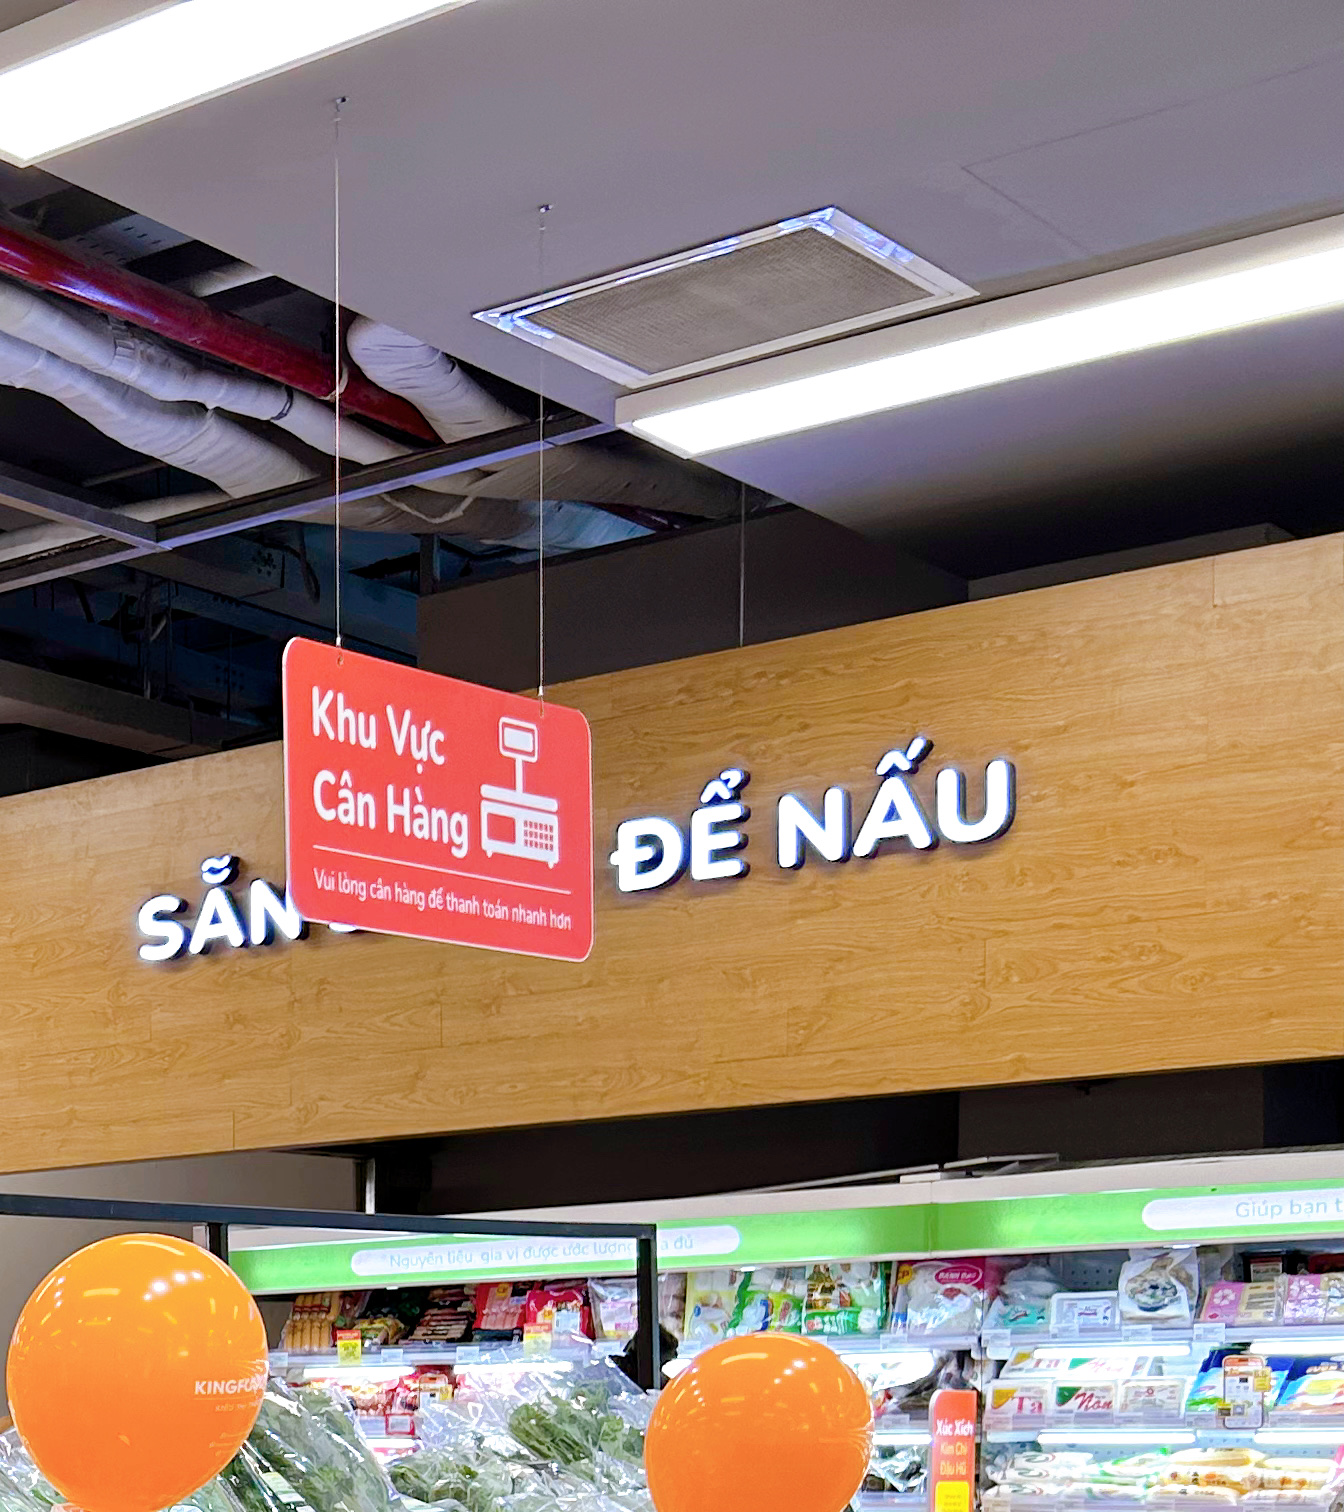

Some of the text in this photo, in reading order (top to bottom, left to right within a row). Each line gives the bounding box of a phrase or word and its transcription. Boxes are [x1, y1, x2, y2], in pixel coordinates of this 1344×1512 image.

[312, 685, 446, 774] Khu Vực
[313, 769, 469, 859] Cân Hàng
[610, 768, 746, 893] ĐỂ
[776, 736, 1016, 870] NẤU
[313, 867, 572, 931] Vui lòng cân hàng để thanh toán nhanh hơn
[936, 1418, 974, 1437] Xúc Xích
